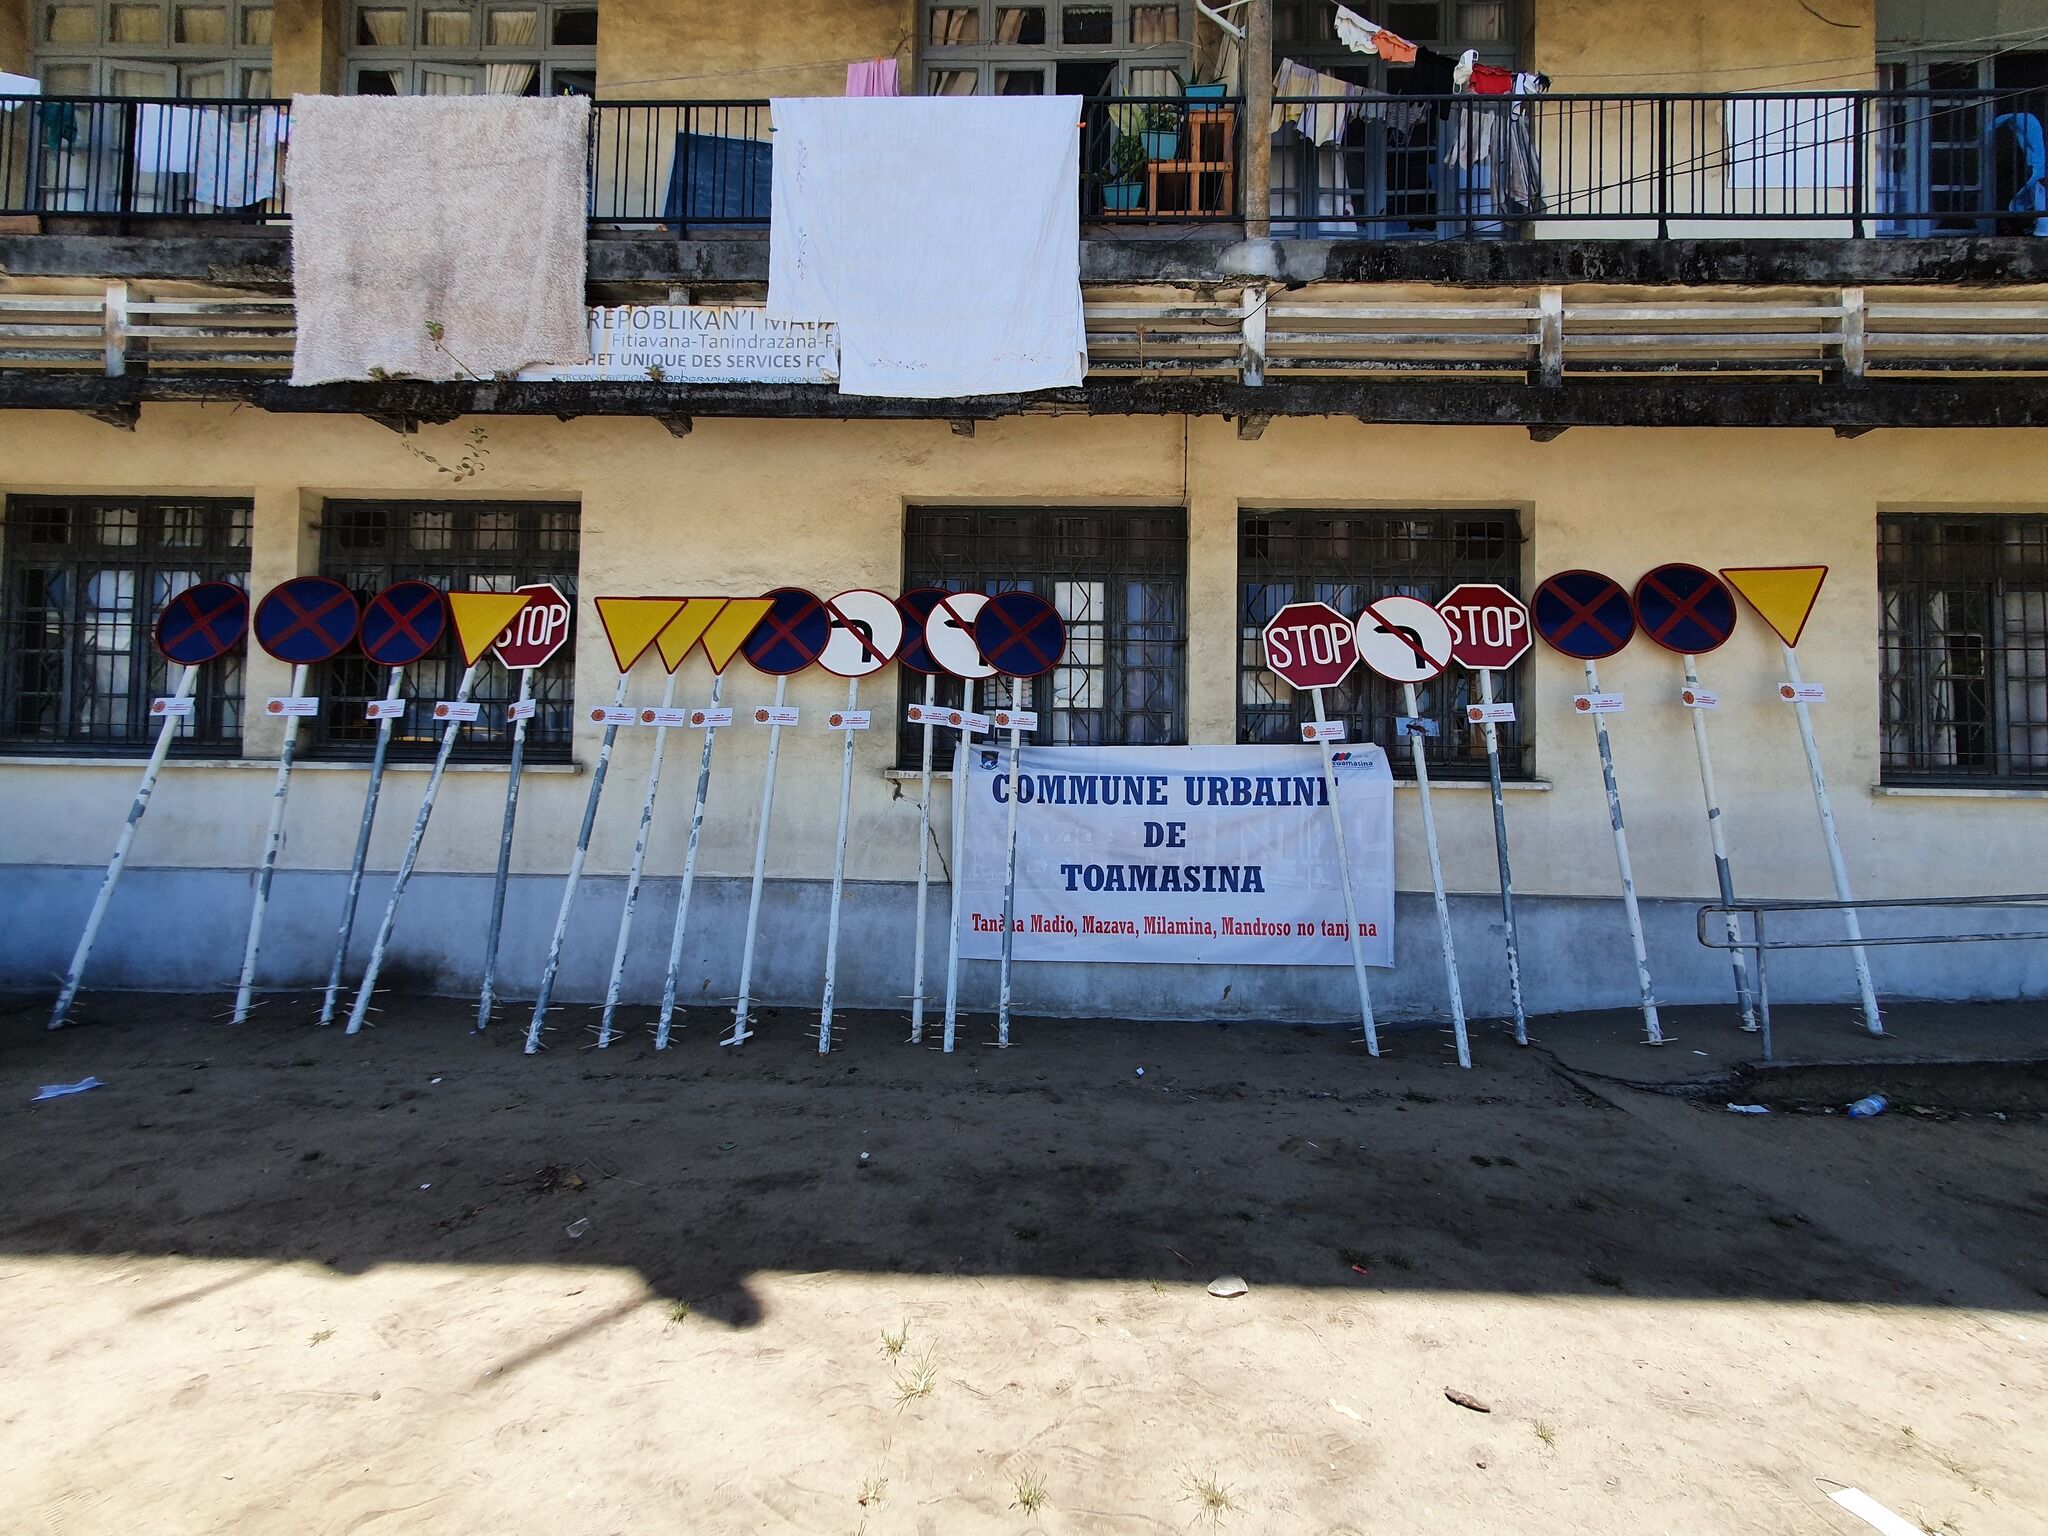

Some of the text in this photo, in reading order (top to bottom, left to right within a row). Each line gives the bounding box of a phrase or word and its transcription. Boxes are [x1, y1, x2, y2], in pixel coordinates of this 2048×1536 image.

[621, 353, 687, 368] UNIQUE
[692, 354, 722, 368] DES
[726, 354, 801, 369] SERVICES
[1441, 605, 1526, 647] STOP
[1268, 623, 1352, 669] STOP
[992, 773, 1168, 806] COMMUNE
[1143, 821, 1186, 848] DE
[1060, 864, 1266, 893] TOAMASINA
[1030, 915, 1078, 937] Madio,
[1082, 916, 1140, 939] Mazava,
[1144, 916, 1217, 940] Milamina,
[1221, 917, 1291, 937] Mandroso
[1297, 922, 1315, 936] no
[1320, 919, 1377, 941] tanjna
